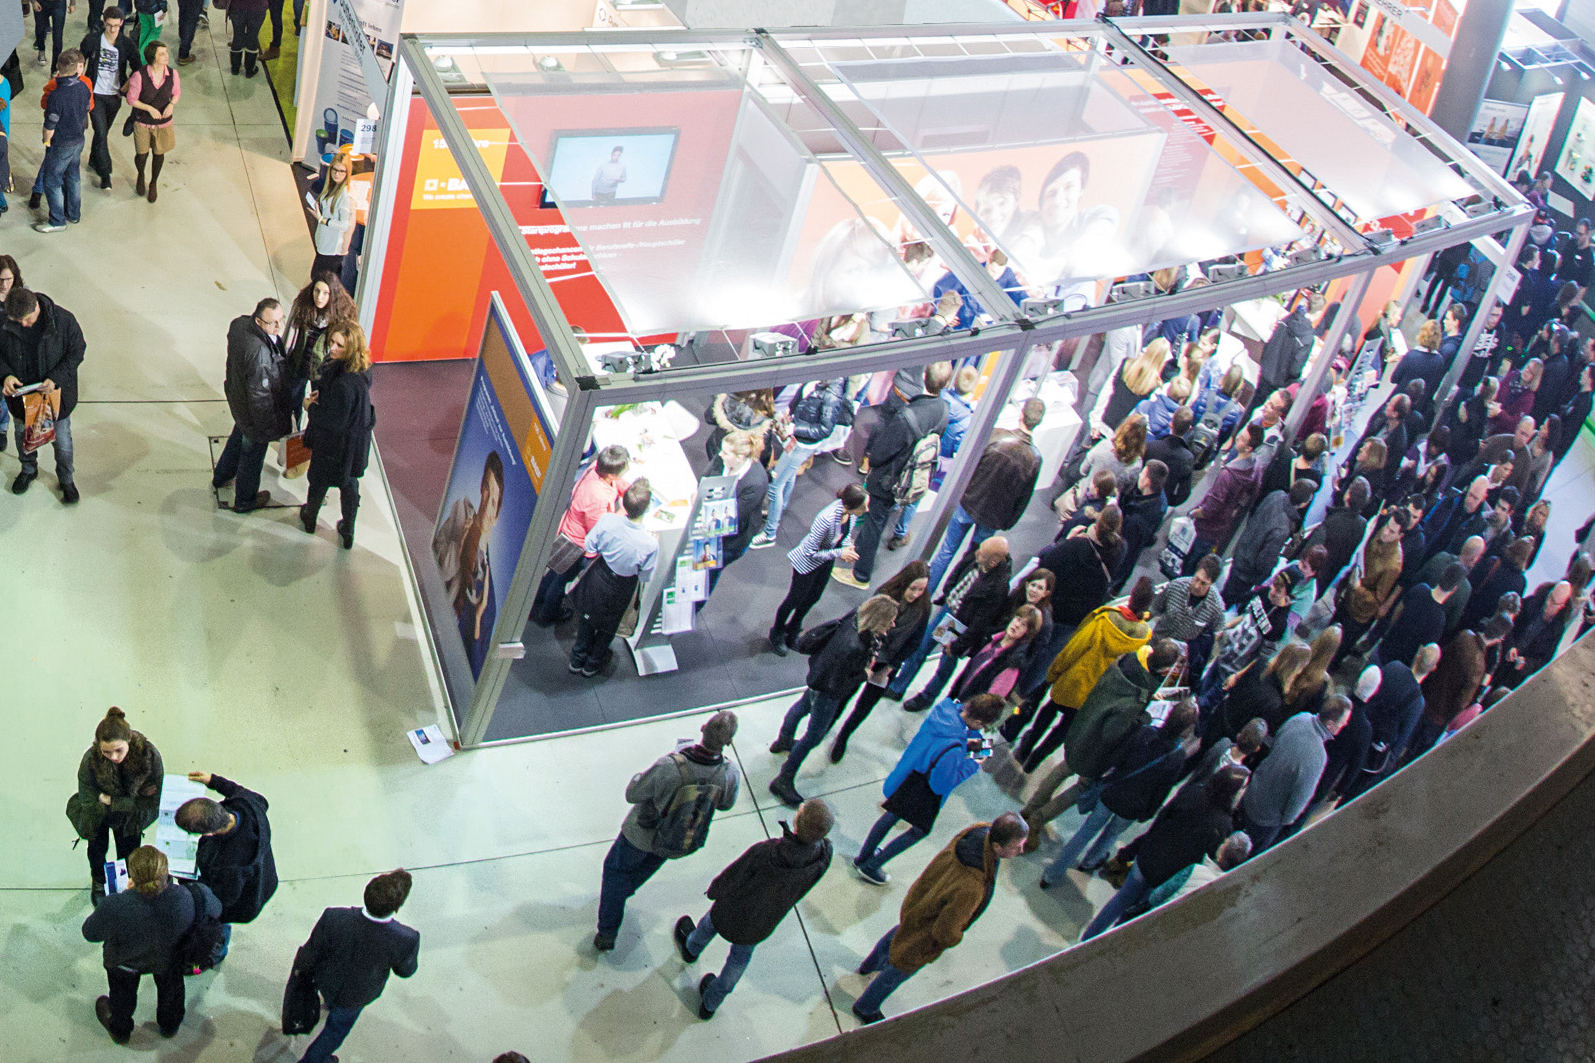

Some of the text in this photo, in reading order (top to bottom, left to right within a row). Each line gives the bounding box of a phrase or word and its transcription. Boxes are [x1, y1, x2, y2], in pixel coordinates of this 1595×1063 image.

[360, 124, 377, 132] 298
[433, 139, 447, 149] 15
[447, 178, 470, 191] BA
[658, 217, 701, 227] Ausbildung
